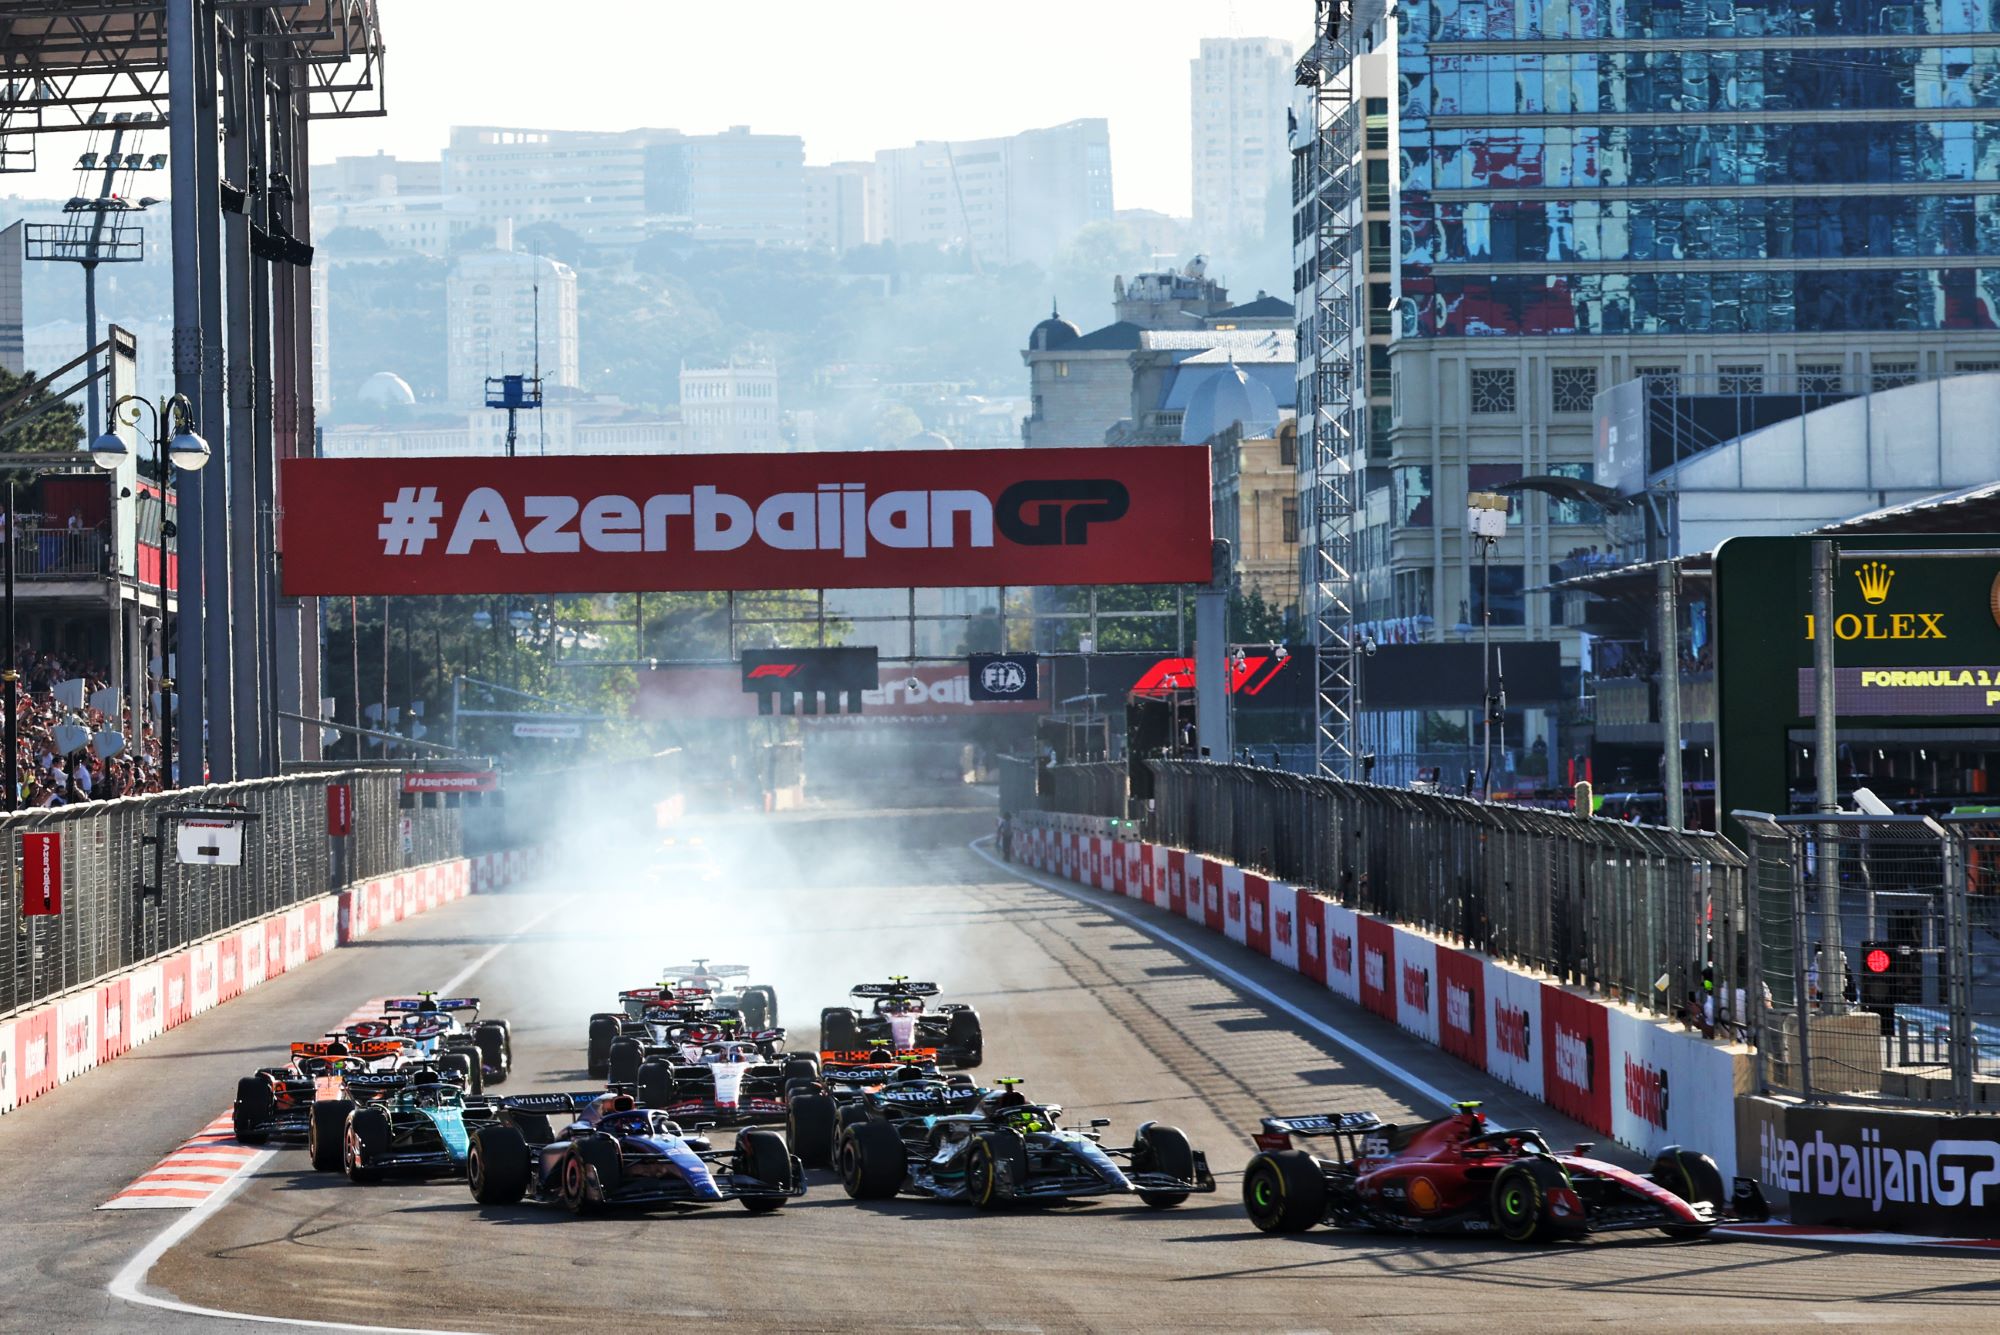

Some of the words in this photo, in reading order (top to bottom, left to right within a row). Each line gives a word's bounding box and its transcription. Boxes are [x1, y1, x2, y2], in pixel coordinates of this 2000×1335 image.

[378, 478, 1130, 559] #AzerbaijanGP
[1804, 613, 1947, 640] OLEX
[1861, 670, 1975, 687] FORMULA
[1978, 670, 1991, 686] 1
[636, 988, 698, 998] OREN
[1760, 1119, 2000, 1212] #AzerbaijanGP
